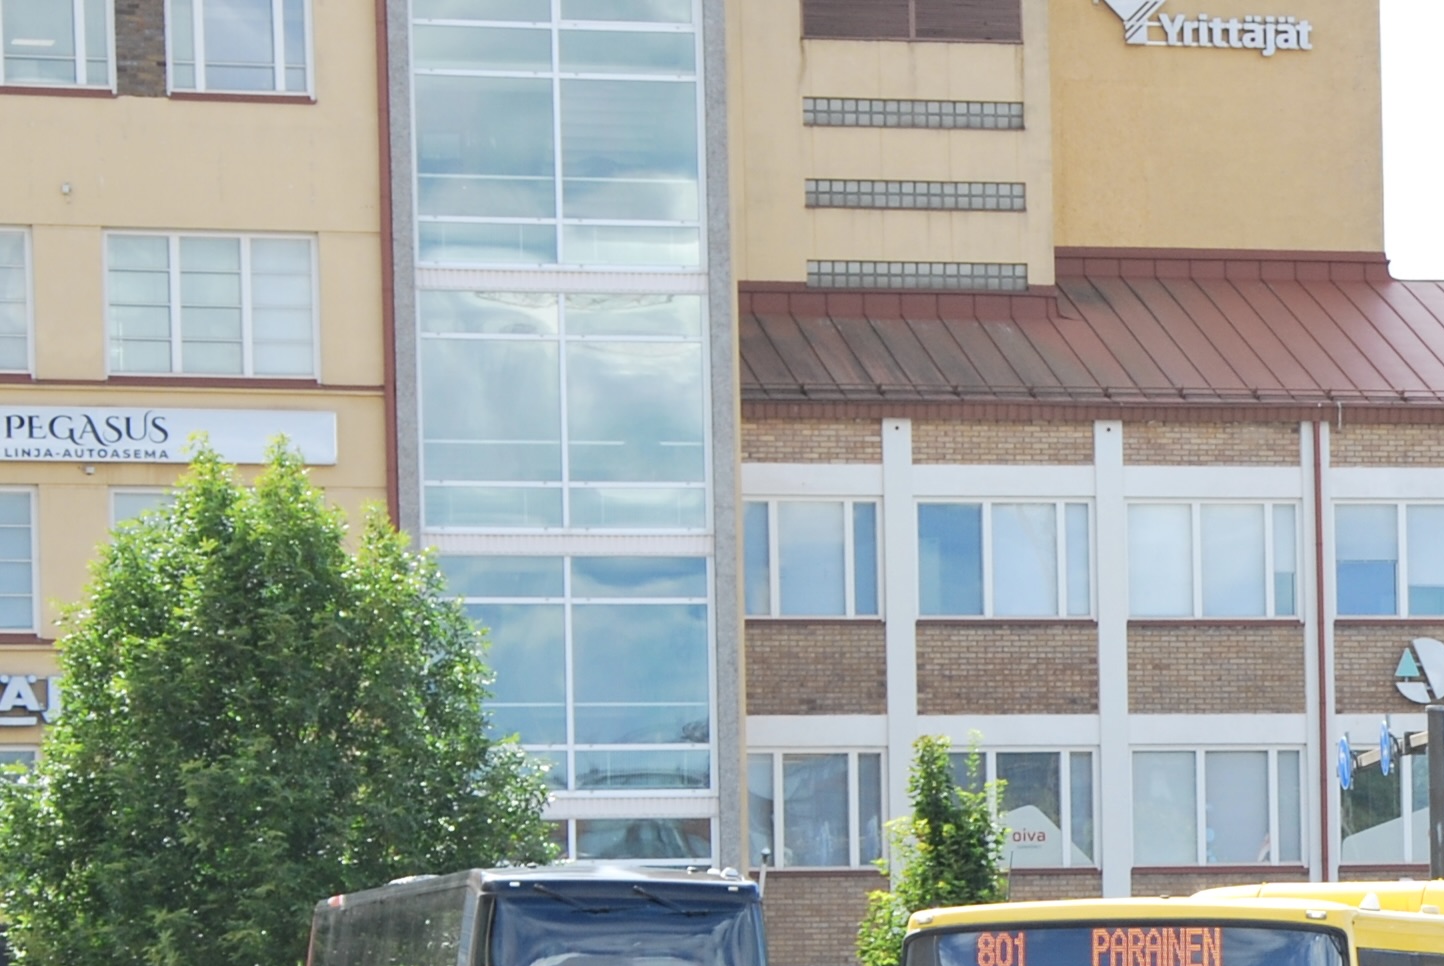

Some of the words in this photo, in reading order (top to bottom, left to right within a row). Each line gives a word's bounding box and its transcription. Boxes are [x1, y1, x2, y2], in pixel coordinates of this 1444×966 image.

[1159, 14, 1313, 57] Yrittäjät
[4, 410, 170, 447] PEGASUS
[4, 448, 170, 459] LINJA-AUTOASEMA
[1012, 827, 1046, 842] oiva
